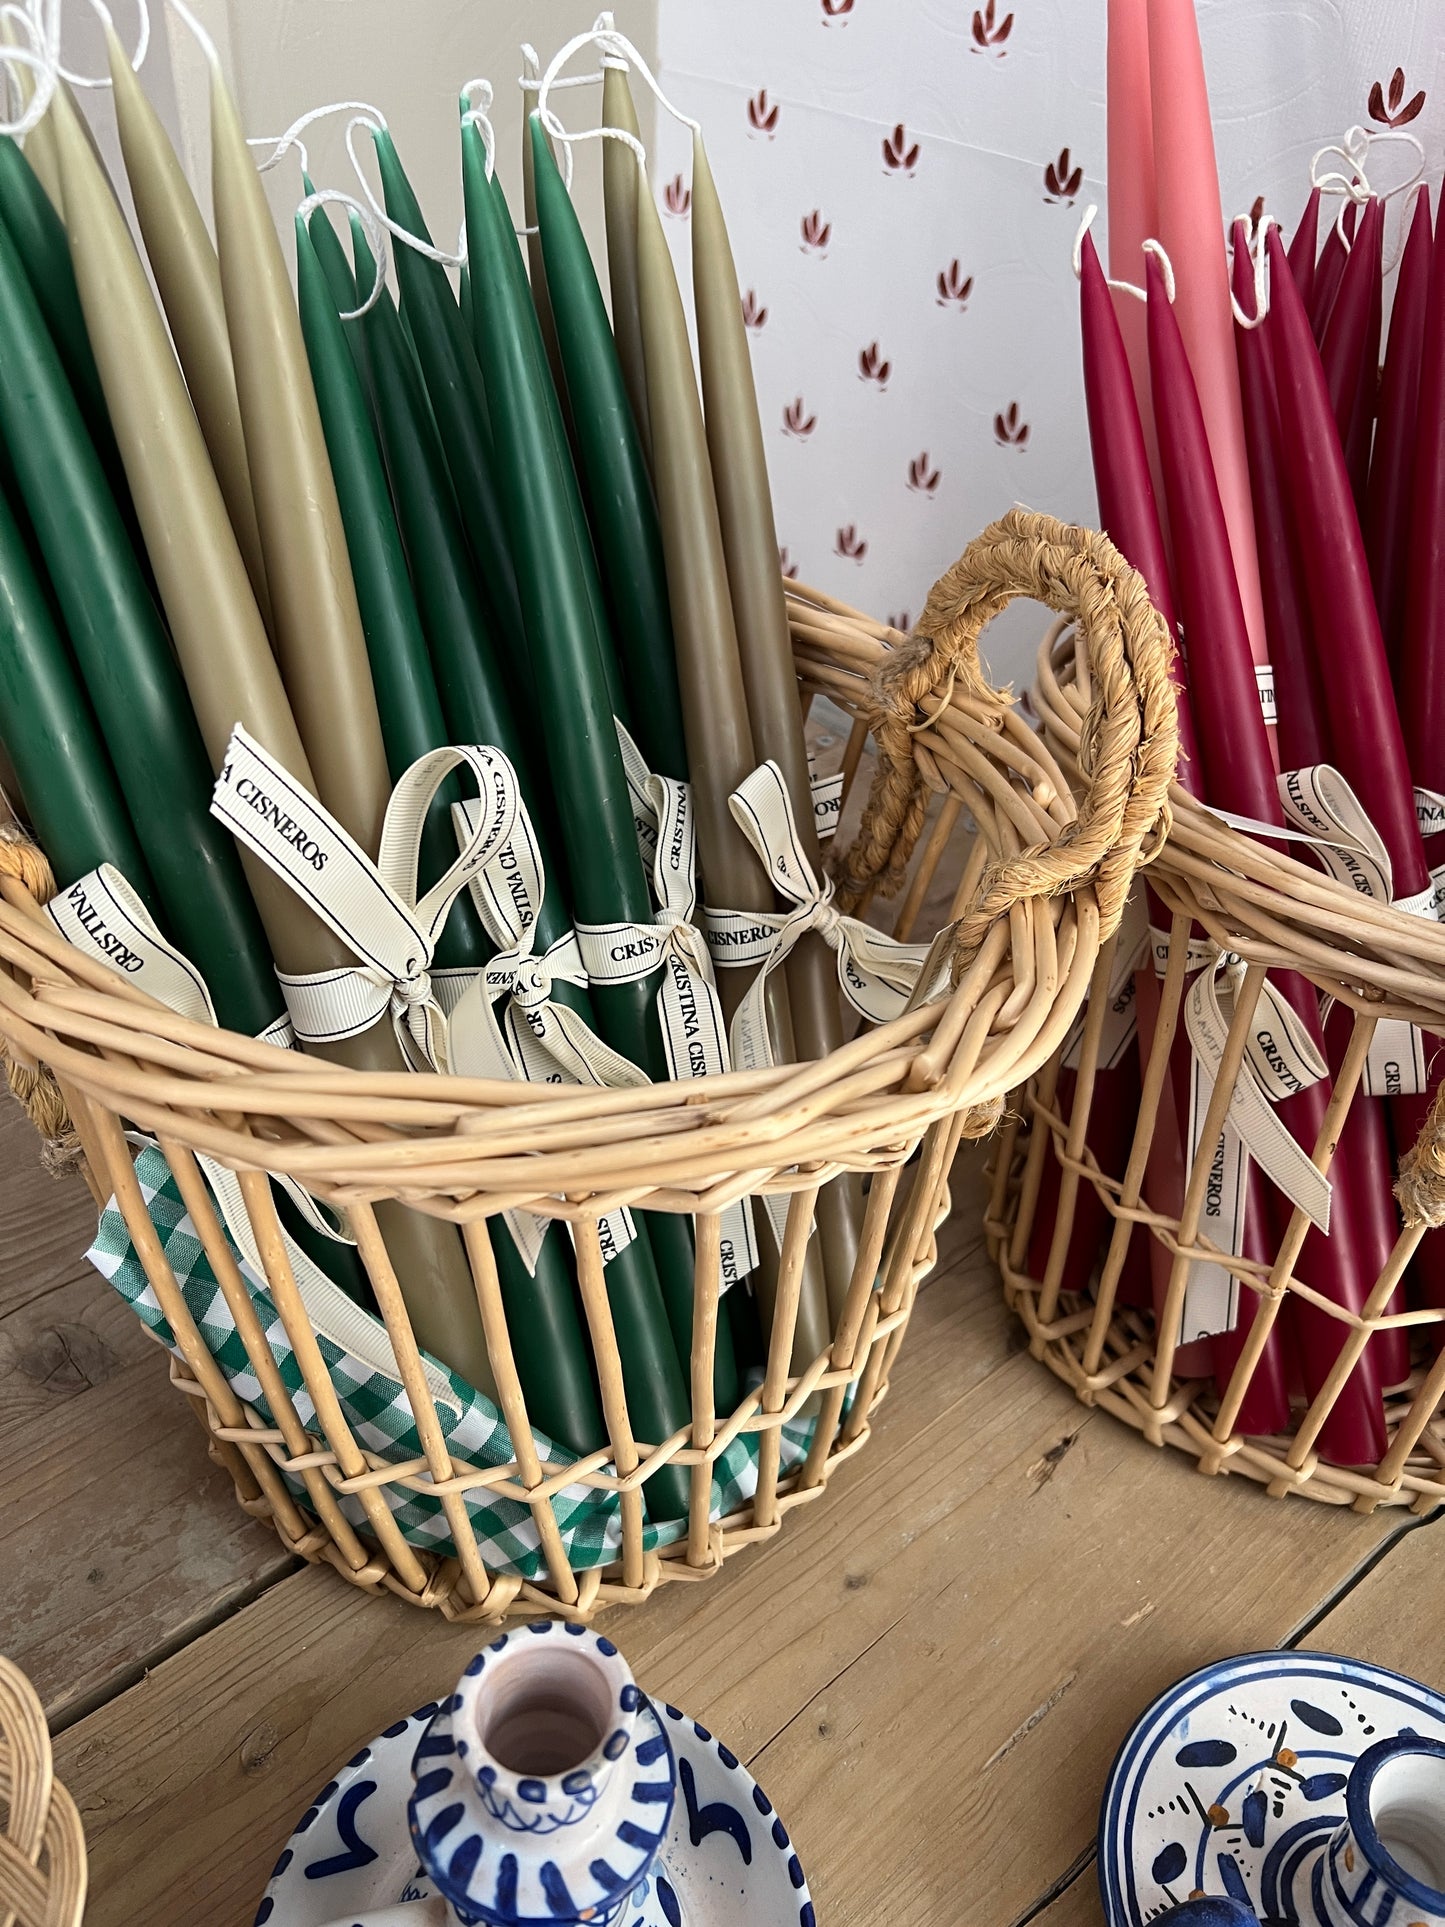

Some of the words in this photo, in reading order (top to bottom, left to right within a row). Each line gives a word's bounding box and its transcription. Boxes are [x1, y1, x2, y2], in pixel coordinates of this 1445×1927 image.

[236, 778, 329, 871] CISNEROS
[463, 771, 506, 871] CISNEROS
[670, 784, 688, 871] CRISTINA
[68, 883, 145, 973] CRISTINA
[506, 871, 534, 932] ISTINA
[669, 953, 700, 1039] CRISTINA
